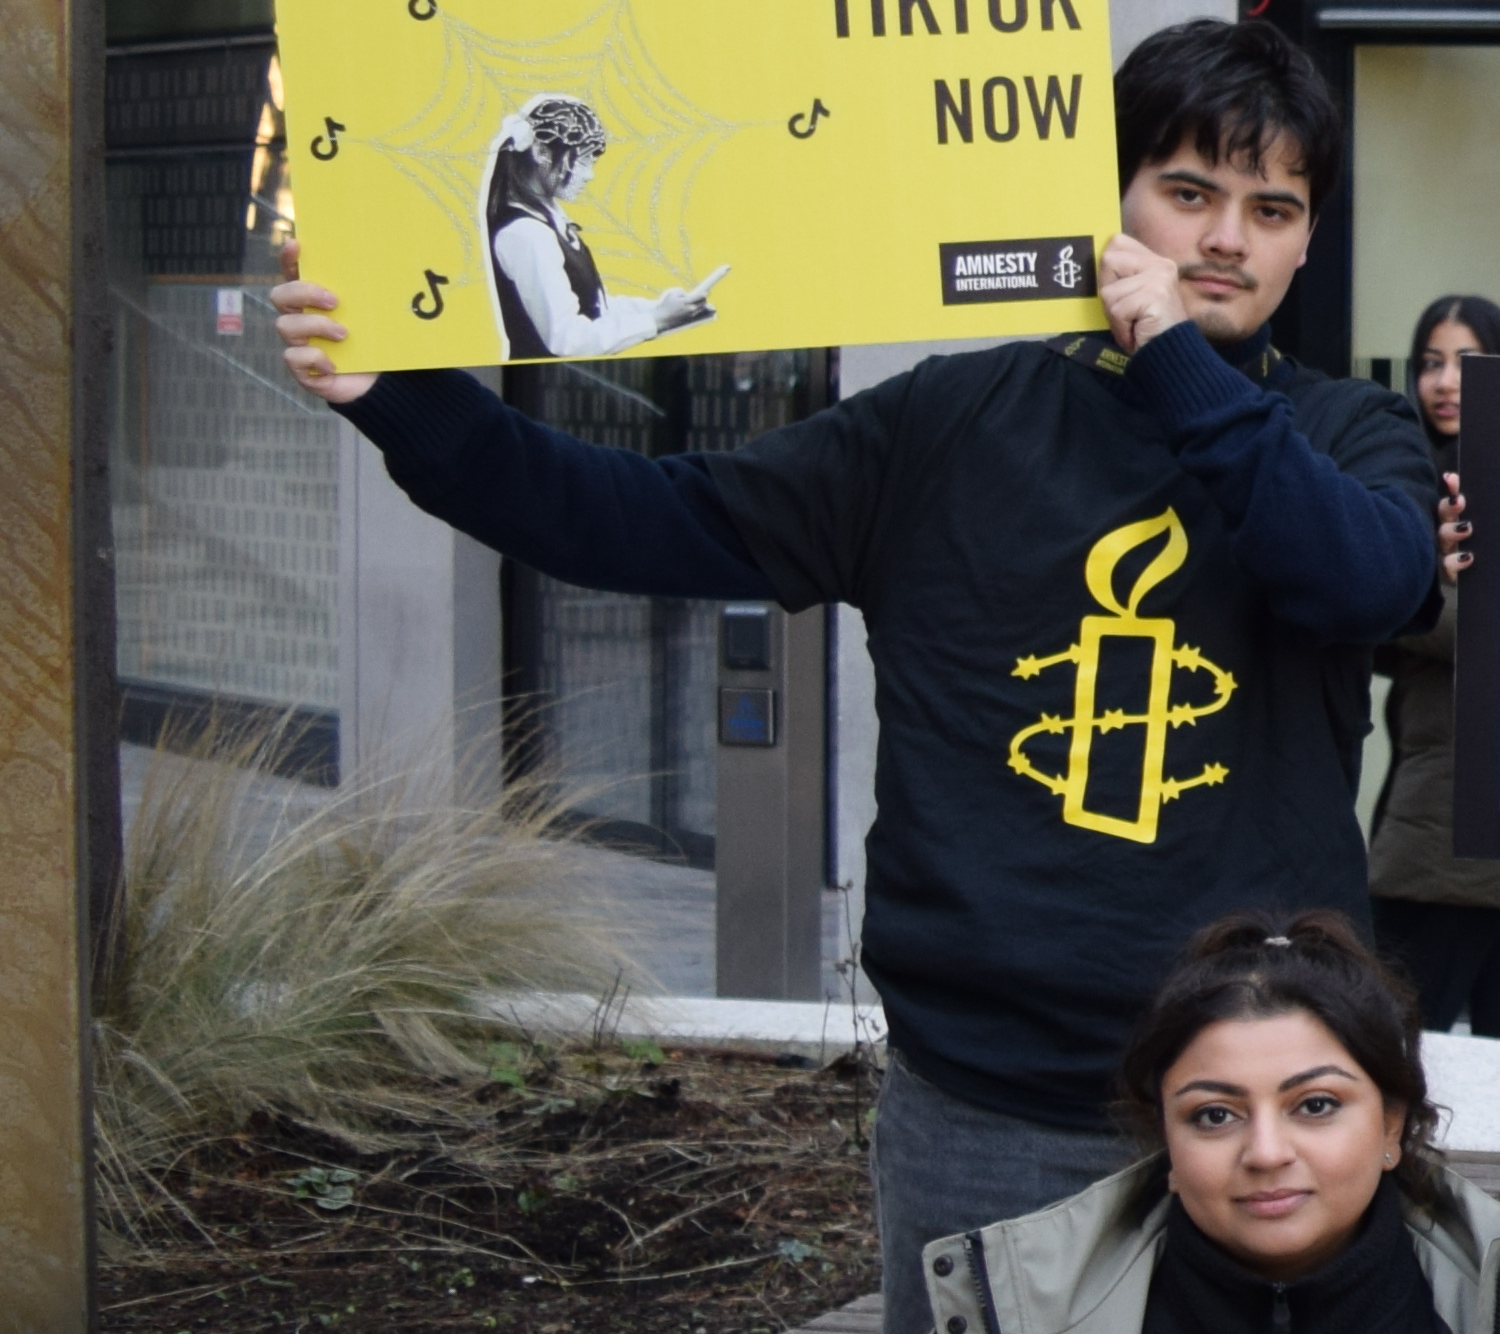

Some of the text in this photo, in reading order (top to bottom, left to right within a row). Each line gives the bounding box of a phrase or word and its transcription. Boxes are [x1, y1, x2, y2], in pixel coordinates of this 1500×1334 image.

[933, 74, 1083, 145] NOW
[955, 252, 1038, 276] AMNESTY
[955, 274, 1039, 292] INTERNATIONAL
